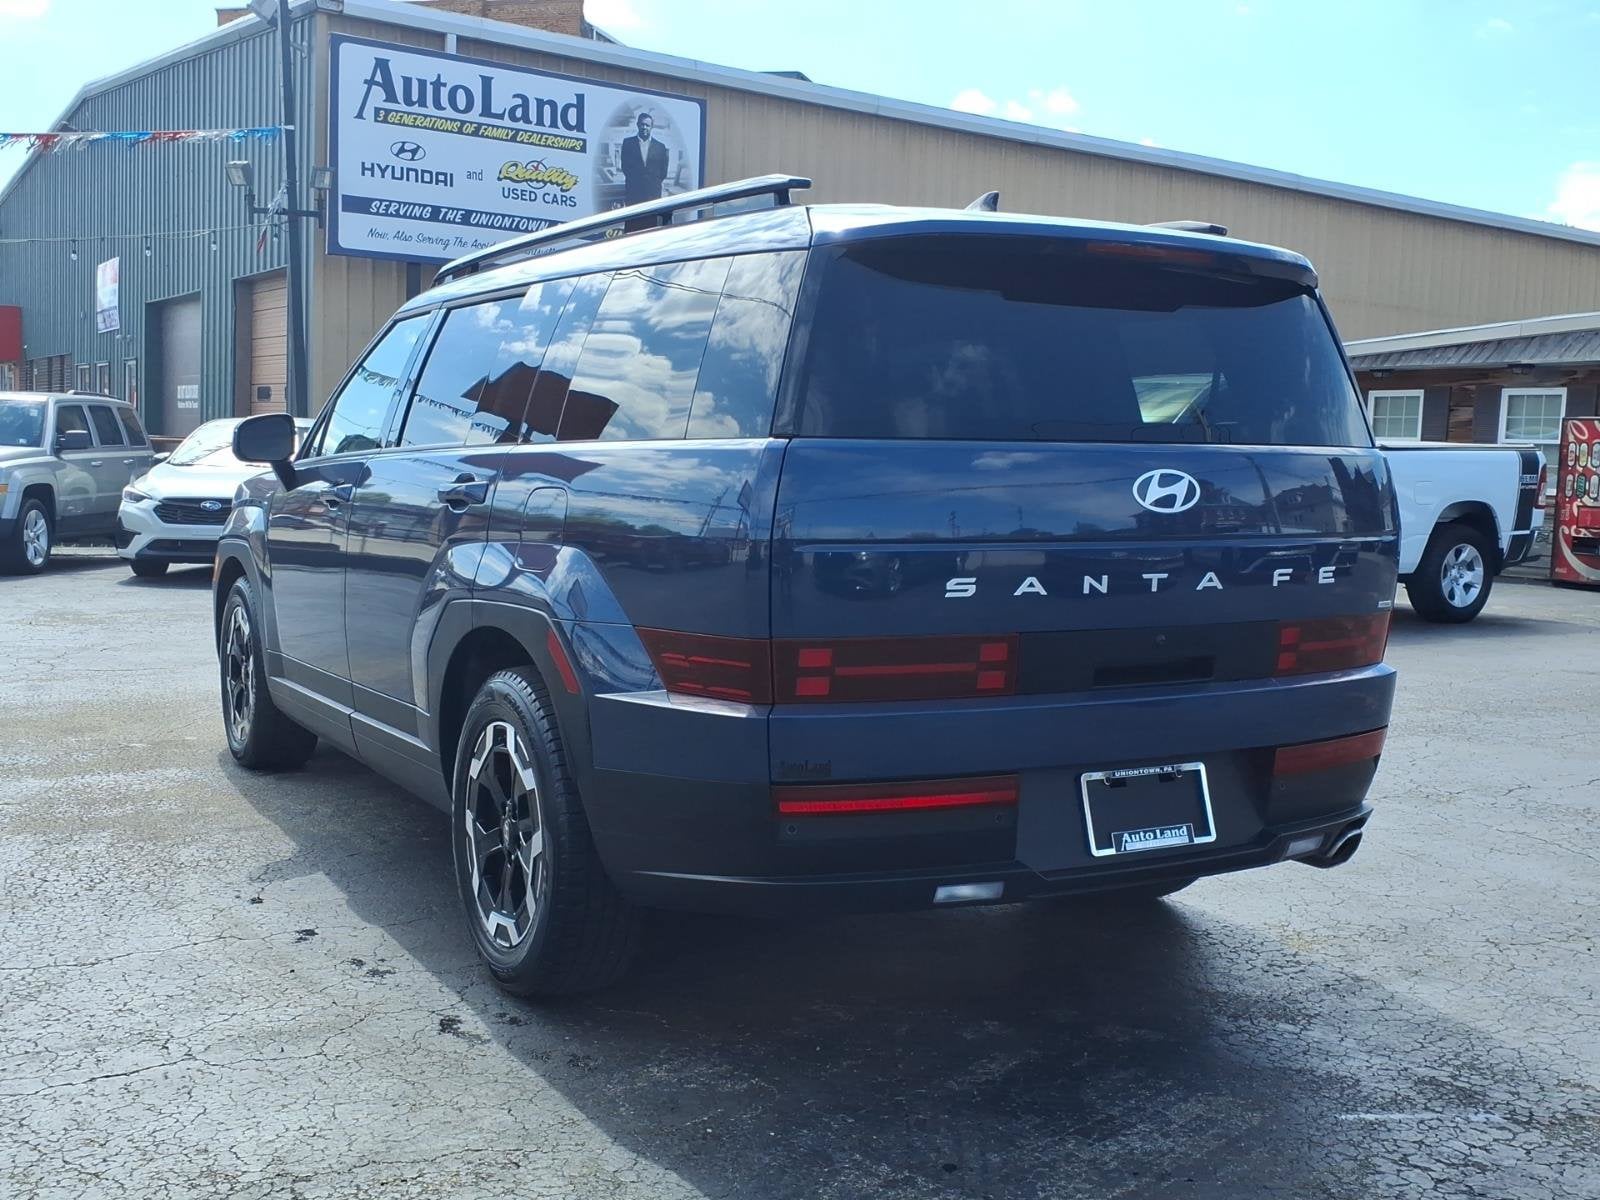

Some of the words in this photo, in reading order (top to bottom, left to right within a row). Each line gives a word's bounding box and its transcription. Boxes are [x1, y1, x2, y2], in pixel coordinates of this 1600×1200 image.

[353, 57, 586, 134] AutoLand
[376, 110, 384, 121] 3
[387, 111, 459, 132] GENERATIONS
[462, 122, 477, 134] OF
[479, 125, 516, 140] FAMILY
[517, 131, 583, 151] DEALERSHIPS
[361, 161, 454, 188] HYUNDAI
[466, 169, 483, 181] and
[497, 160, 580, 192] Quality
[502, 187, 538, 202] USED
[542, 192, 577, 208] CARS
[370, 200, 432, 219] SERVING
[439, 208, 465, 222] THE
[470, 212, 549, 232] UNIONTOWN
[393, 230, 413, 242] Also
[416, 233, 450, 251] Serving
[453, 236, 468, 248] The
[944, 571, 1224, 598] SANTA
[1272, 565, 1337, 587] FE
